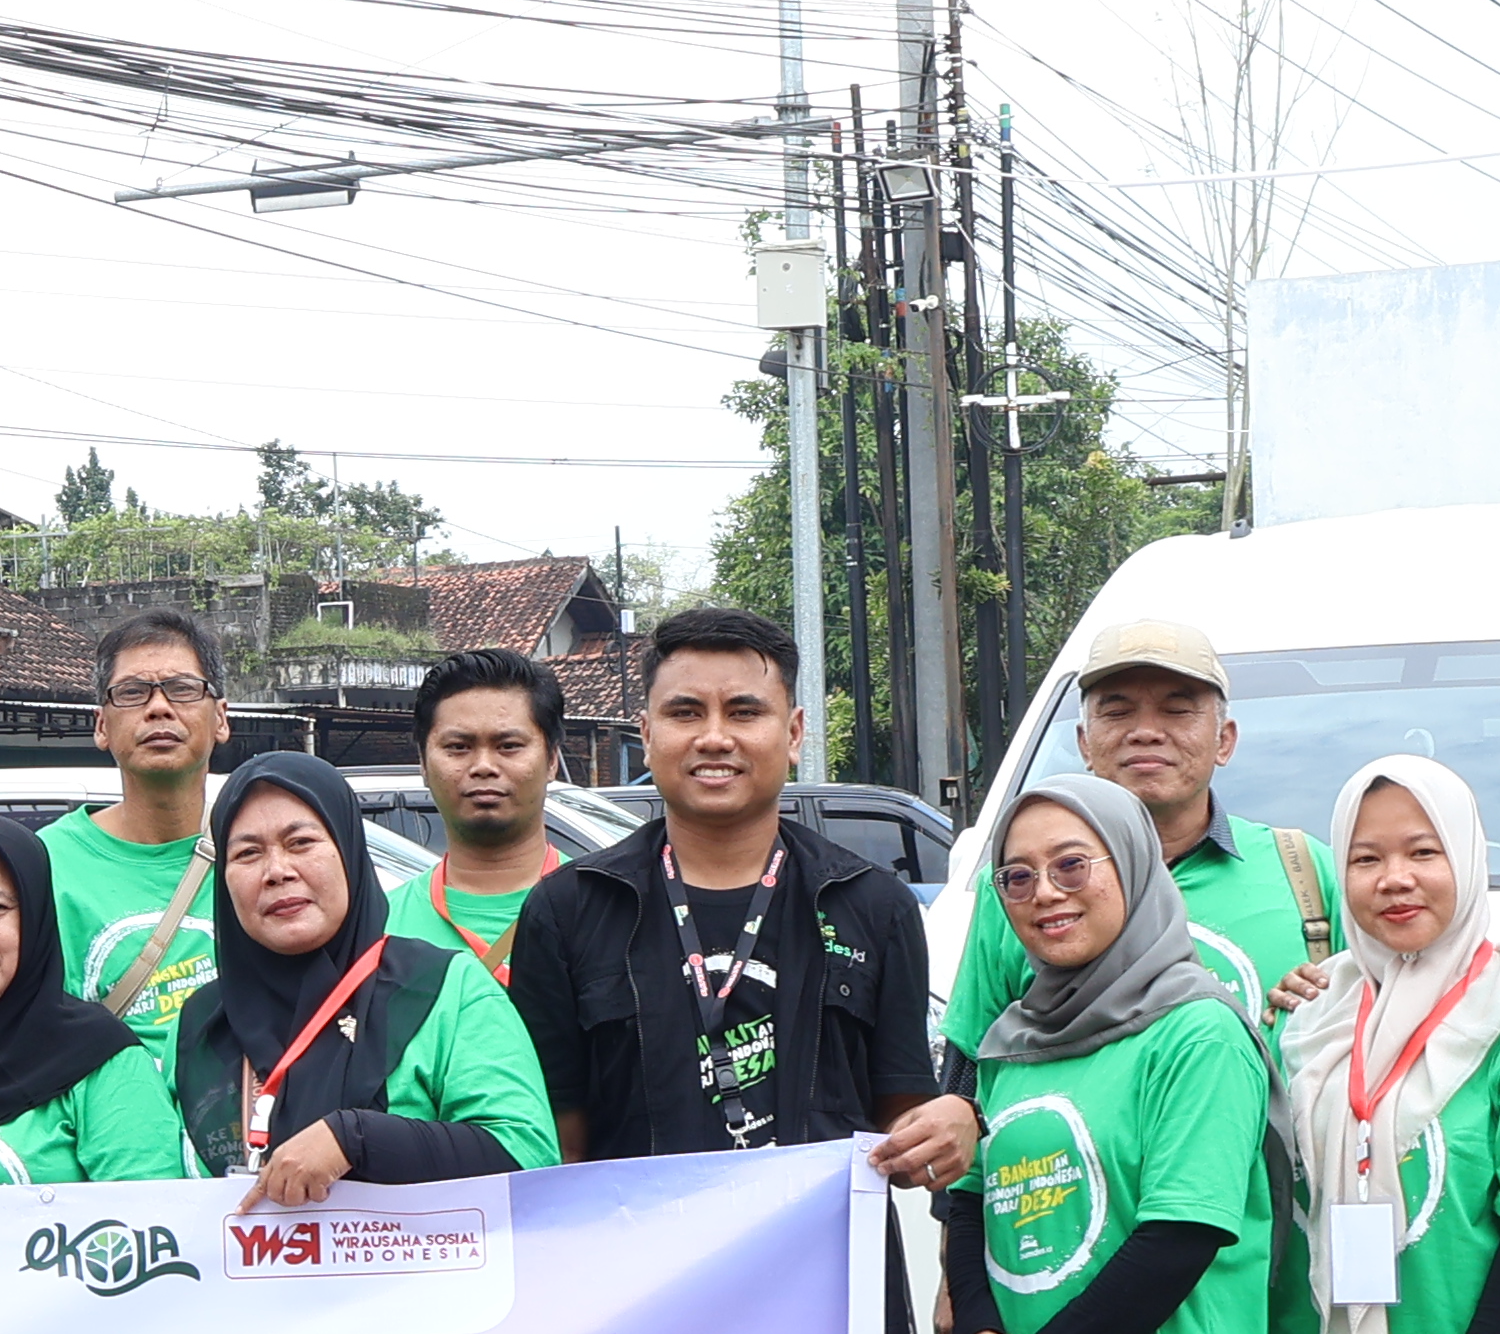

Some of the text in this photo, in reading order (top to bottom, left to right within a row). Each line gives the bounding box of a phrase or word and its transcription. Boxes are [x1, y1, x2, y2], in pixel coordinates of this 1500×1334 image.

[732, 1049, 776, 1083] ESA
[329, 1221, 402, 1236] YAYASAN
[332, 1232, 480, 1249] WIRAUSAHA SOSIAL
[331, 1248, 481, 1265] INDONESIA
